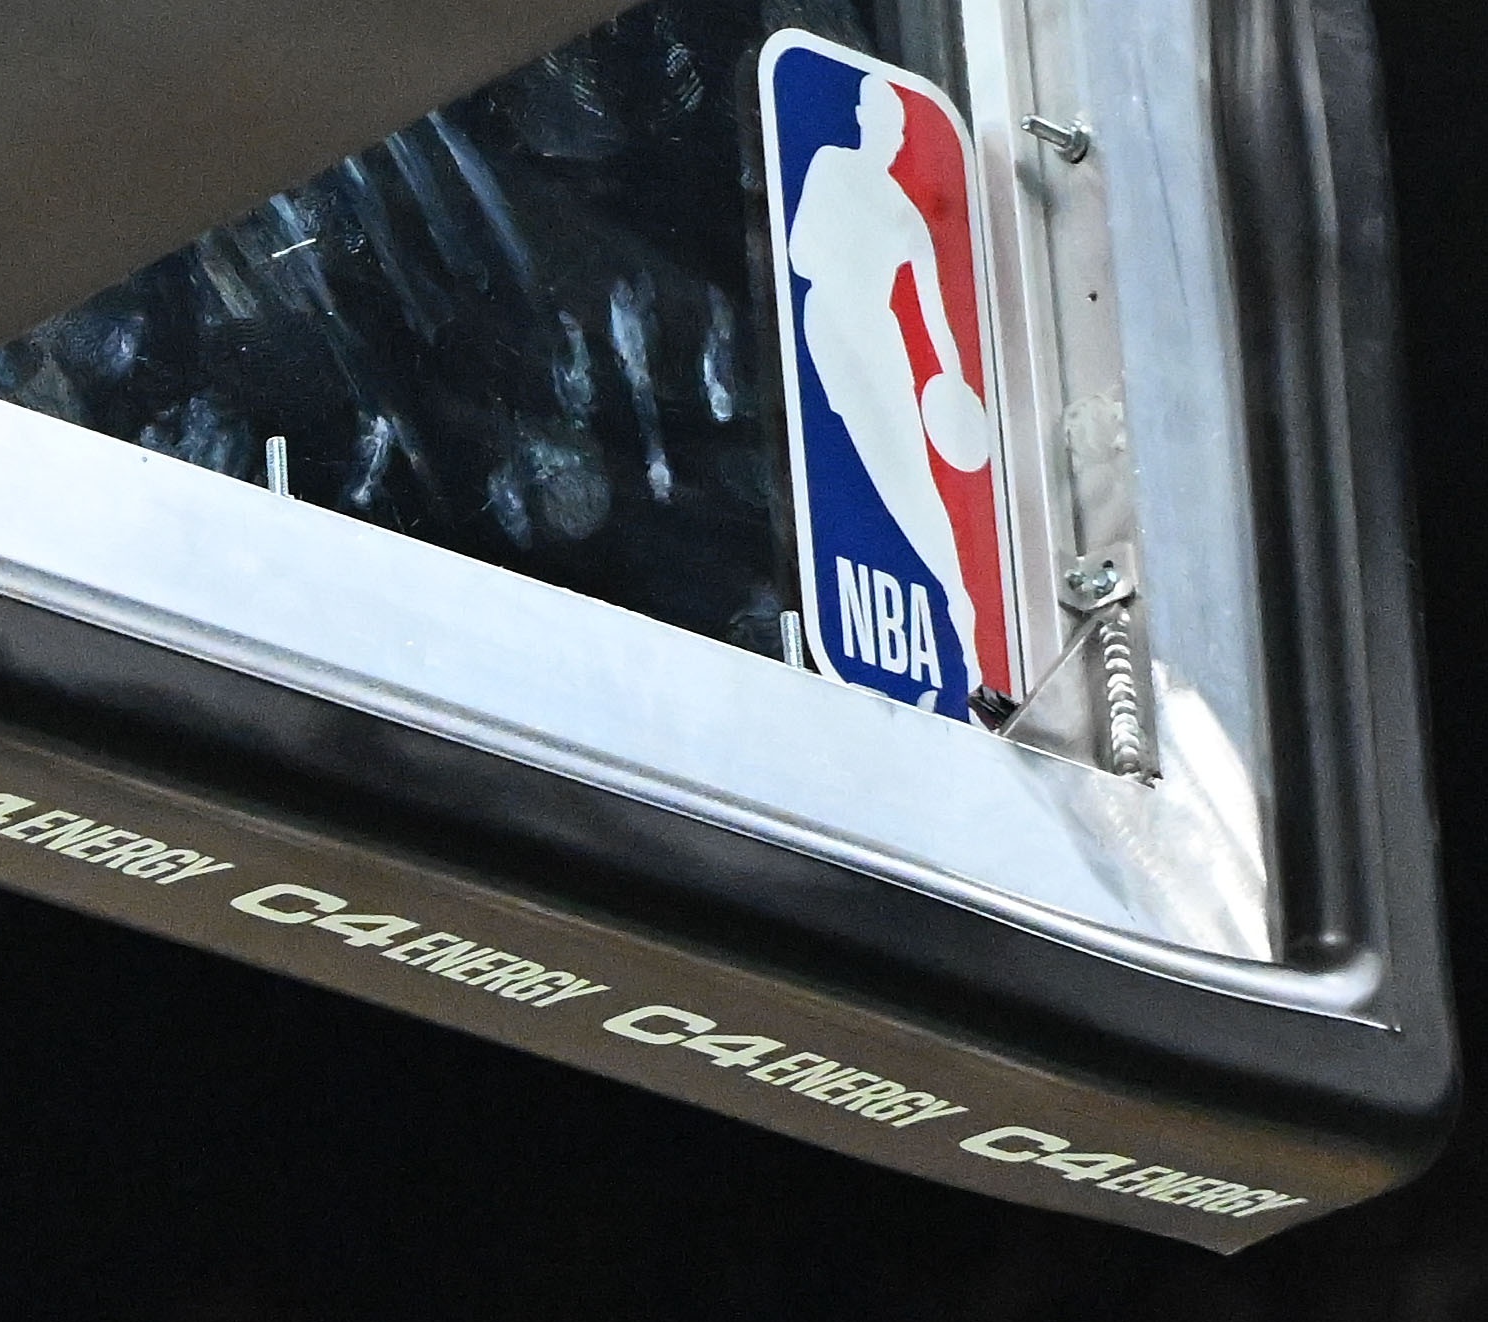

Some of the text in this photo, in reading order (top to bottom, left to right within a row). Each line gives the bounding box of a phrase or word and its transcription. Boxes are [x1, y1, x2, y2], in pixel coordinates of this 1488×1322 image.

[835, 556, 943, 689] NBA
[230, 883, 421, 947] C4
[379, 932, 611, 1007] ENERGY
[602, 1005, 786, 1068] C4
[746, 1052, 969, 1132] ENERGY
[959, 1126, 1137, 1182] C4
[1096, 1166, 1309, 1217] ENERGY
